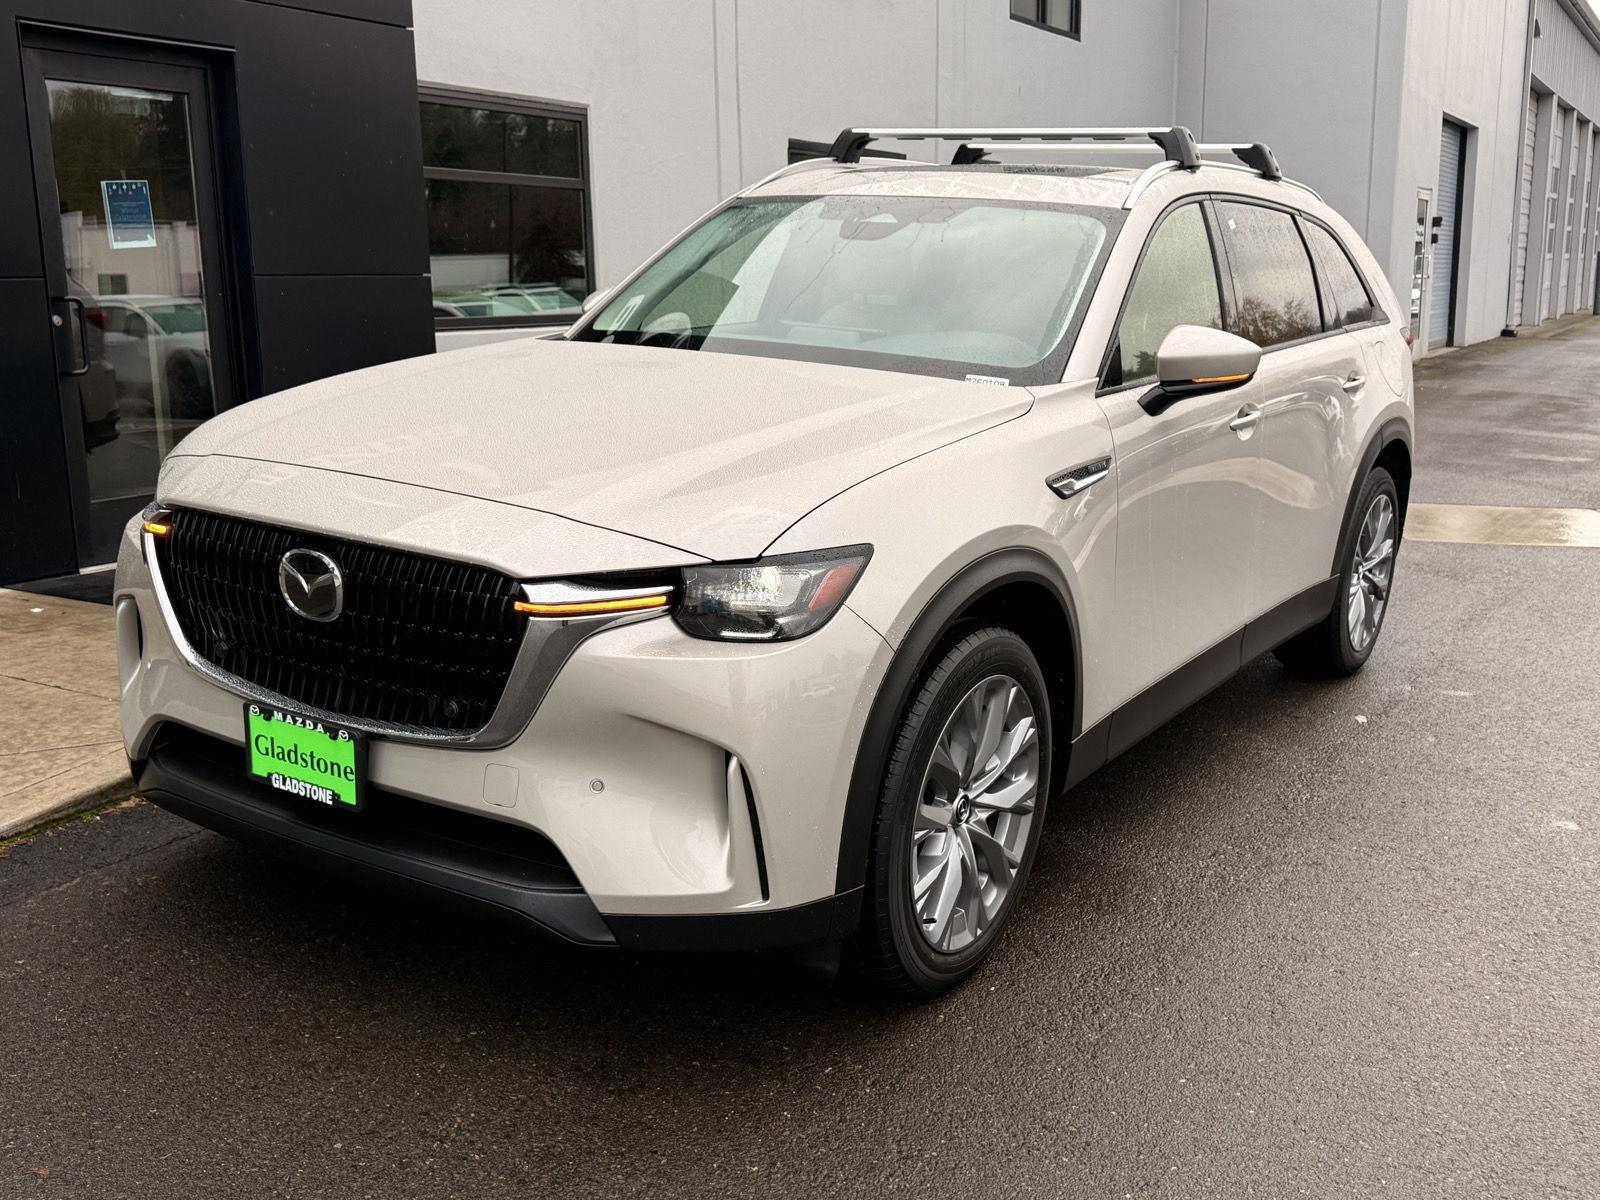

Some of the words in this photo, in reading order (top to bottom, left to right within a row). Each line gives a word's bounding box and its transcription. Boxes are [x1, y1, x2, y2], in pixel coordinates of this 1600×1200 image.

[273, 710, 325, 734] MAZDA
[254, 734, 355, 782] Gladstone
[271, 773, 334, 806] GLADSTONE
